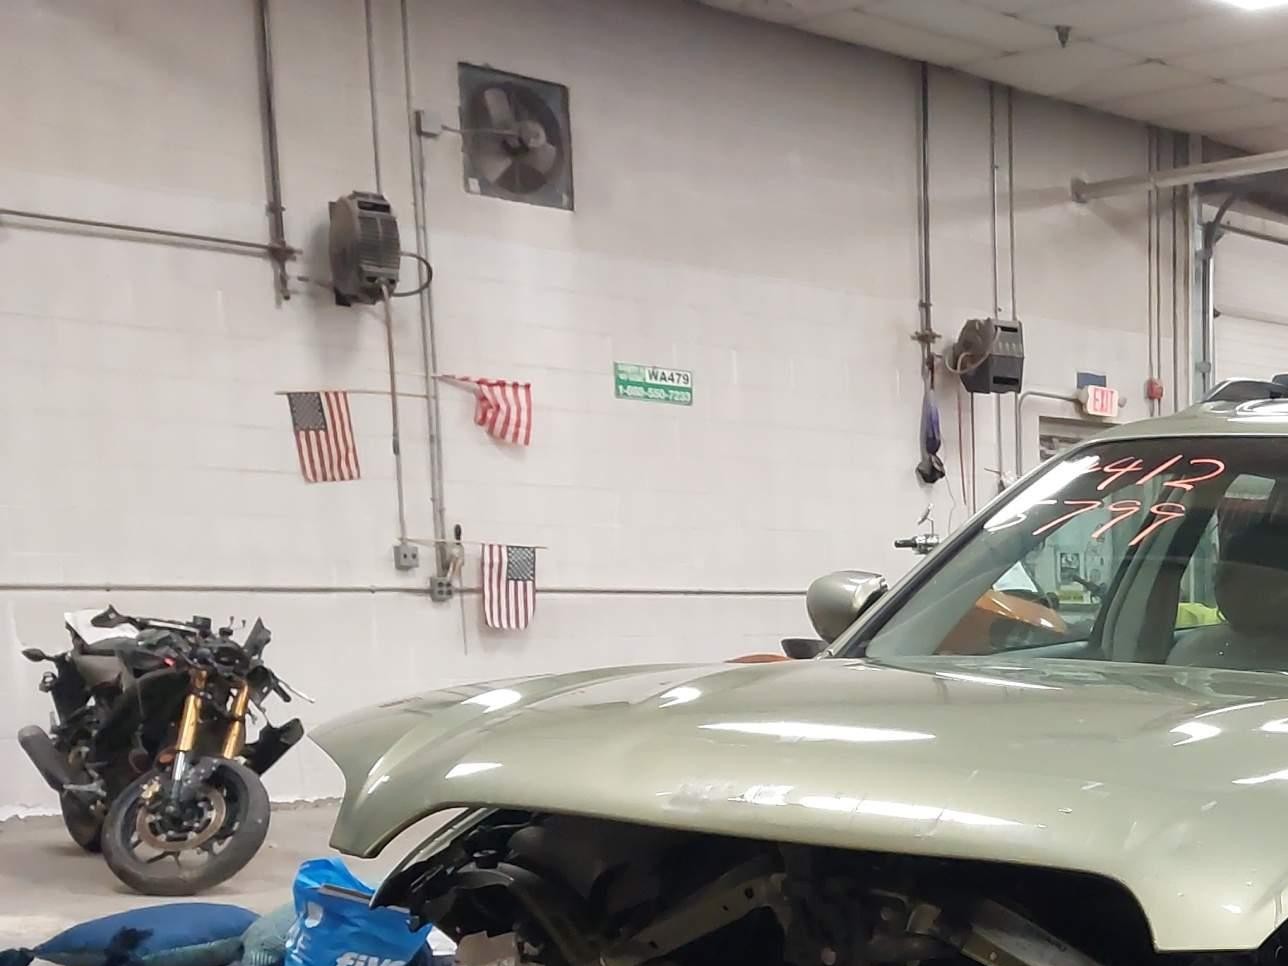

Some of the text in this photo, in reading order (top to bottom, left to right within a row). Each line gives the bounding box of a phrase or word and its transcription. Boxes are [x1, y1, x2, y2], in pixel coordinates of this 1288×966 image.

[648, 370, 690, 385] WA479
[1093, 388, 1115, 413] EXIT
[1086, 455, 1225, 491] 412
